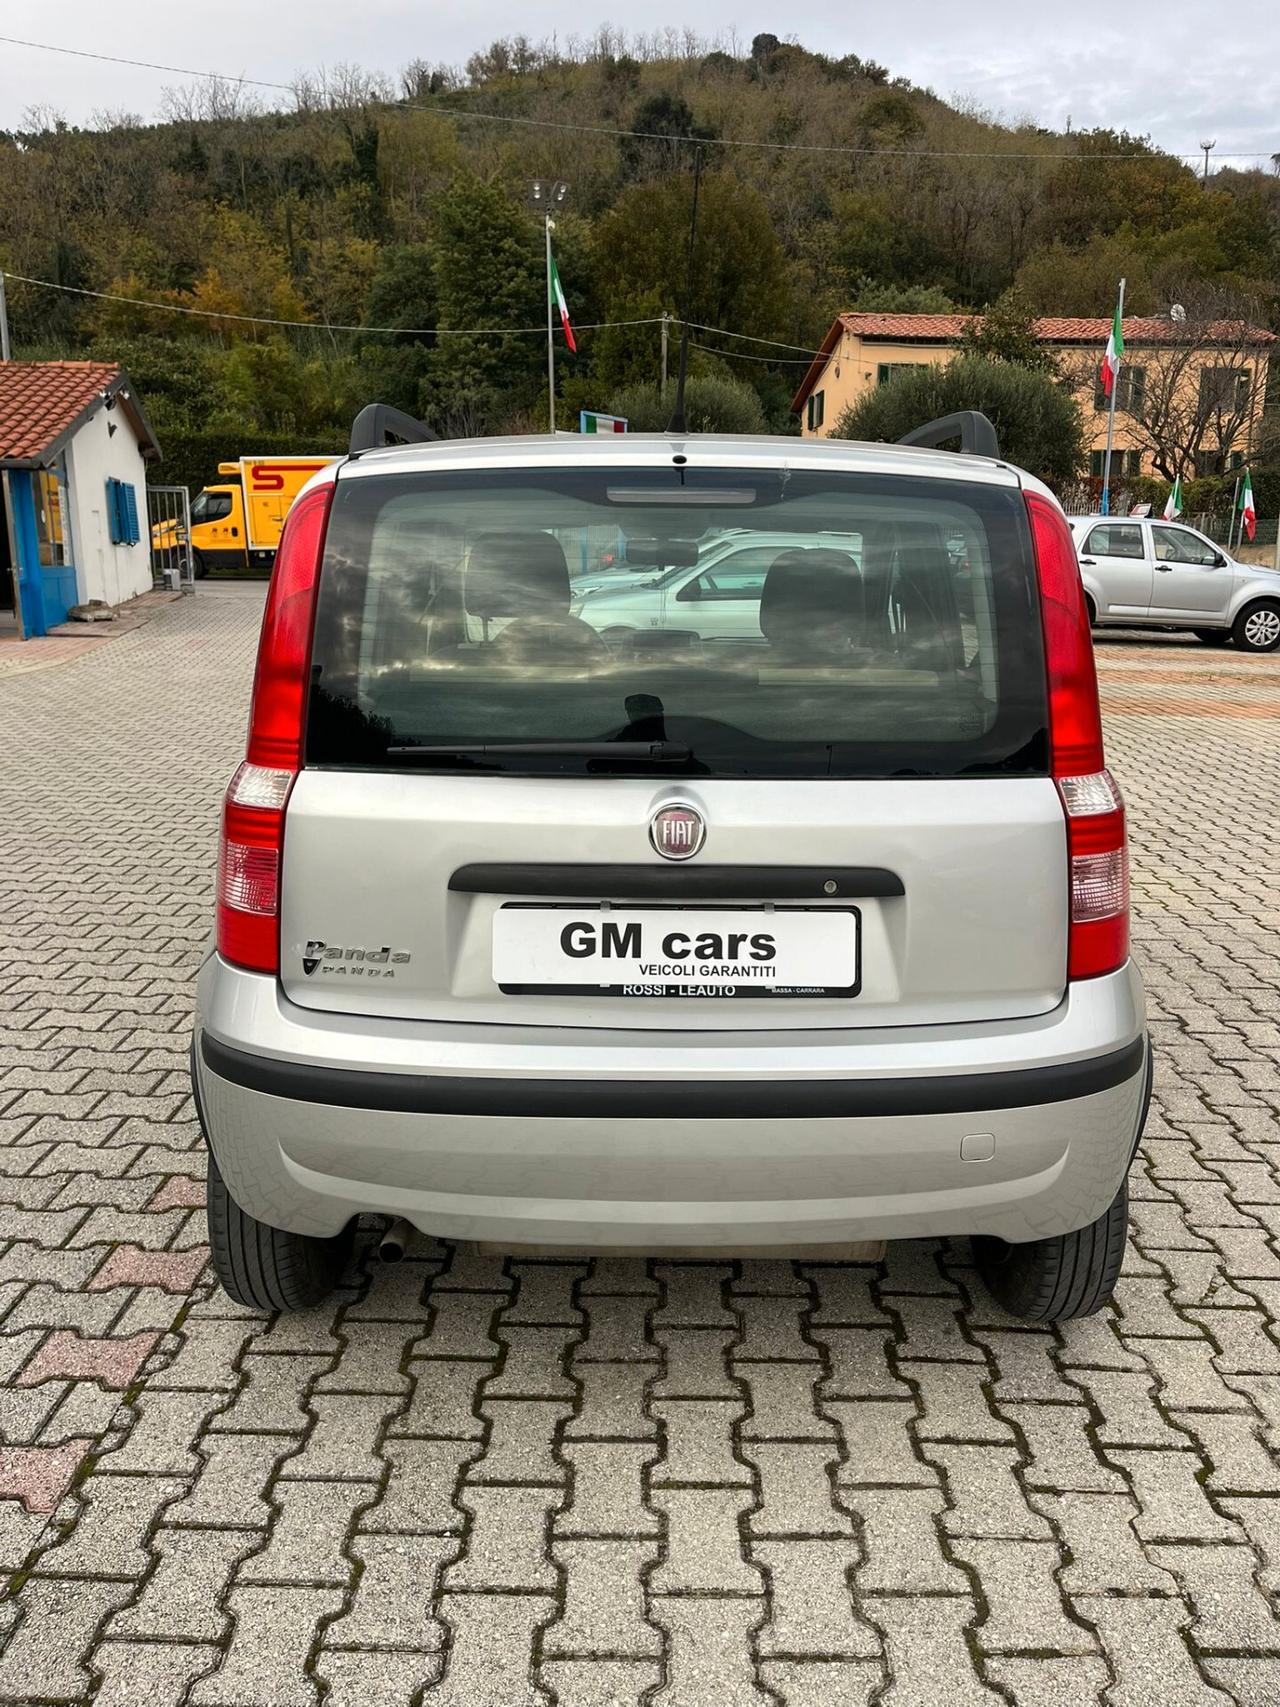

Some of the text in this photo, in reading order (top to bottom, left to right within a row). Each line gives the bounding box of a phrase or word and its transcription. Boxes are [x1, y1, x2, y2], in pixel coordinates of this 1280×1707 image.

[662, 820, 695, 845] FIAT
[560, 921, 776, 961] GM cars
[304, 940, 411, 964] Panda
[321, 965, 395, 978] PANDA
[639, 964, 776, 977] VEICOLI GARANTITI
[623, 984, 666, 995] ROSSI
[679, 985, 736, 996] LEAUTO
